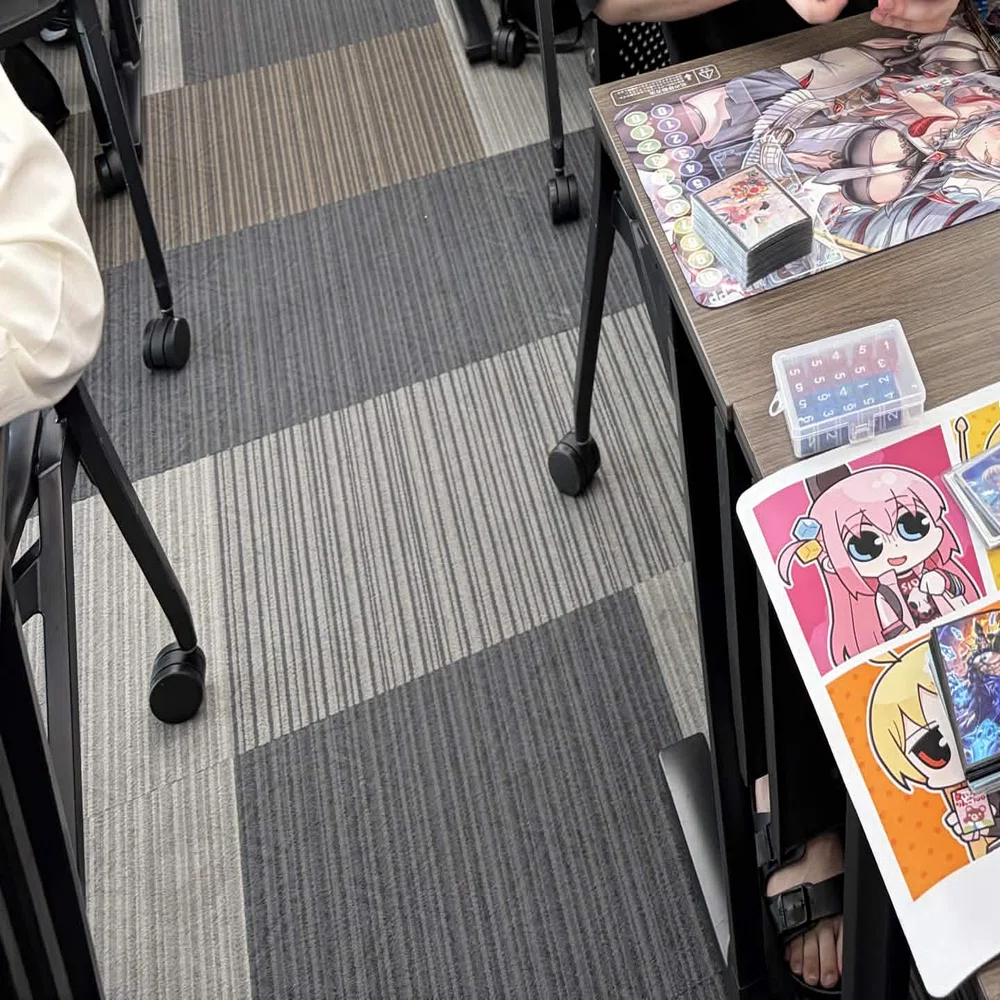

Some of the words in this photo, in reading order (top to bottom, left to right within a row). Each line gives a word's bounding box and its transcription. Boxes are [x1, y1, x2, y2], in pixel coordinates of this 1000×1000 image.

[832, 350, 840, 360] 4
[811, 359, 823, 367] 5
[877, 358, 886, 368] 3
[789, 368, 801, 376] 5
[854, 365, 866, 374] 5
[814, 375, 826, 384] 5
[834, 371, 846, 380] 5
[840, 386, 848, 396] 4
